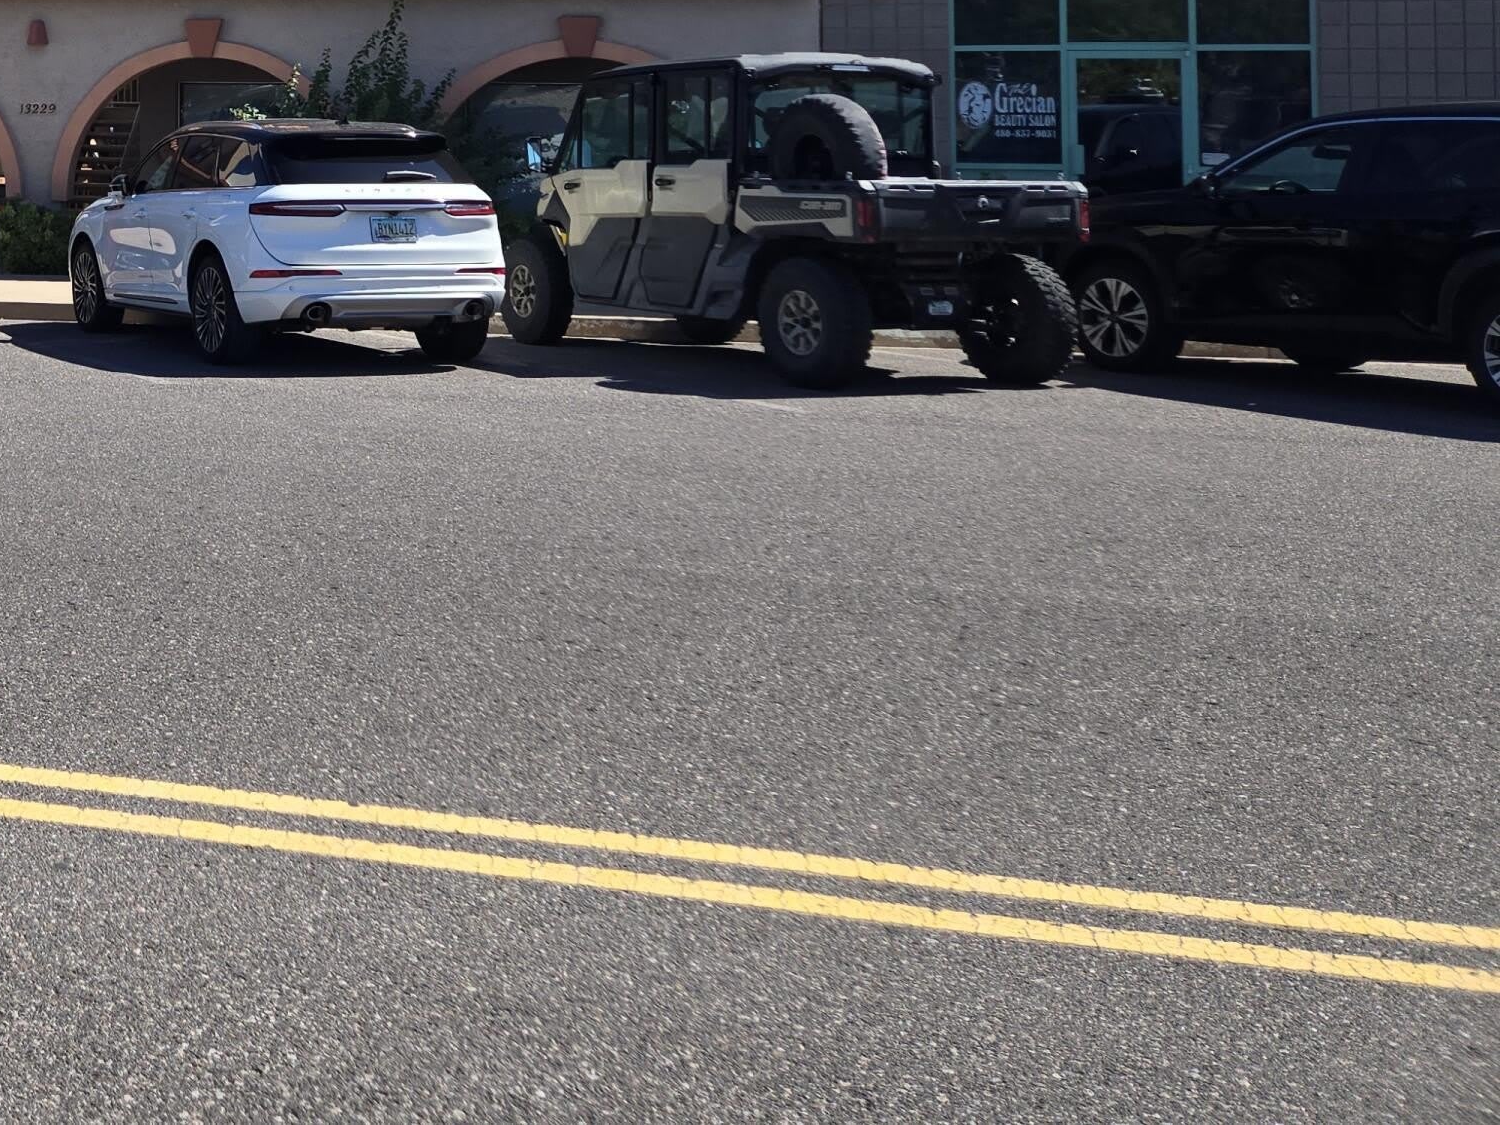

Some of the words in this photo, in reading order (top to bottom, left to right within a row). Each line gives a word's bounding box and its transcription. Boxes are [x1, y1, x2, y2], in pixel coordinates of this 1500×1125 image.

[995, 82, 1056, 113] Grecian
[20, 103, 57, 115] 13229
[995, 114, 1027, 126] BEAUTY
[1028, 114, 1056, 126] SALON
